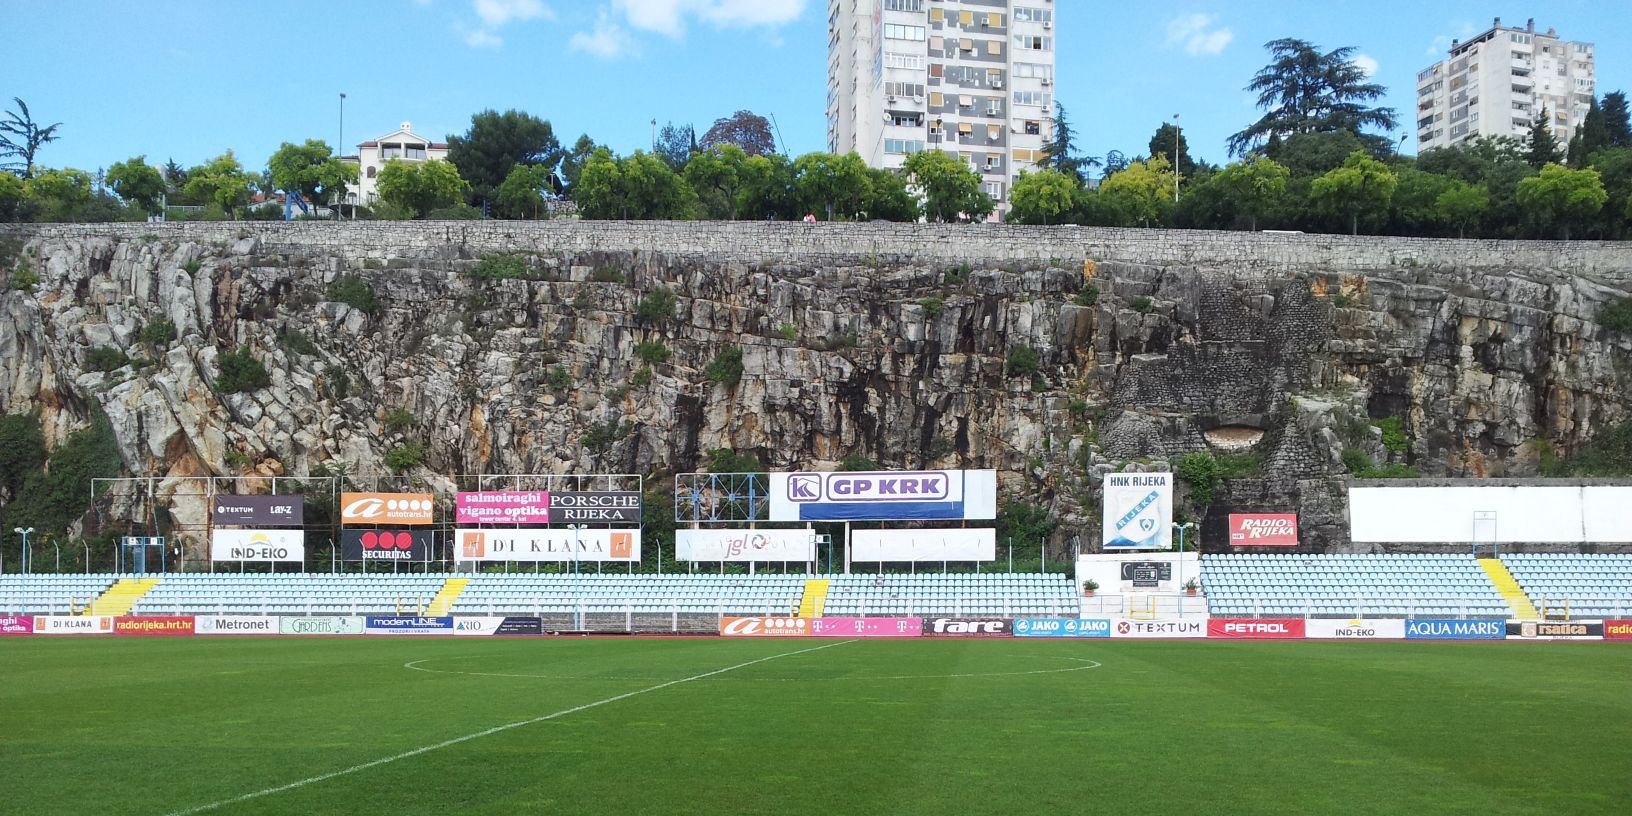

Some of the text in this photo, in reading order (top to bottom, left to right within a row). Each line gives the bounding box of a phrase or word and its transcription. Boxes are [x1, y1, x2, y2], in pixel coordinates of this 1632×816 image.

[833, 478, 941, 495] GP KRK
[1110, 476, 1166, 487] HNK RIJEKA
[465, 493, 541, 504] salmoiraghi
[550, 496, 639, 506] PORSCHE
[459, 505, 547, 518] vigano optika
[564, 509, 624, 519] RIJEKA
[1118, 494, 1156, 527] RIJEKA
[1240, 519, 1287, 530] RADIO
[1248, 527, 1294, 538] RIJEKA
[493, 539, 603, 552] DI KLANA
[231, 548, 288, 559] IND-EKO
[362, 550, 411, 559] SECURITAS
[53, 620, 92, 628] DI KLANA
[116, 619, 192, 631] radiorijeka.hrt.hr
[215, 619, 269, 630] Metronet
[932, 618, 1004, 633] fare
[1031, 621, 1060, 631] JAKO
[1079, 621, 1108, 631] JAKO
[1135, 623, 1200, 632] TEXTUM
[1225, 623, 1289, 633] PETROL
[1408, 622, 1499, 635] AQUA MARIS
[764, 627, 806, 635] autotrans.hr
